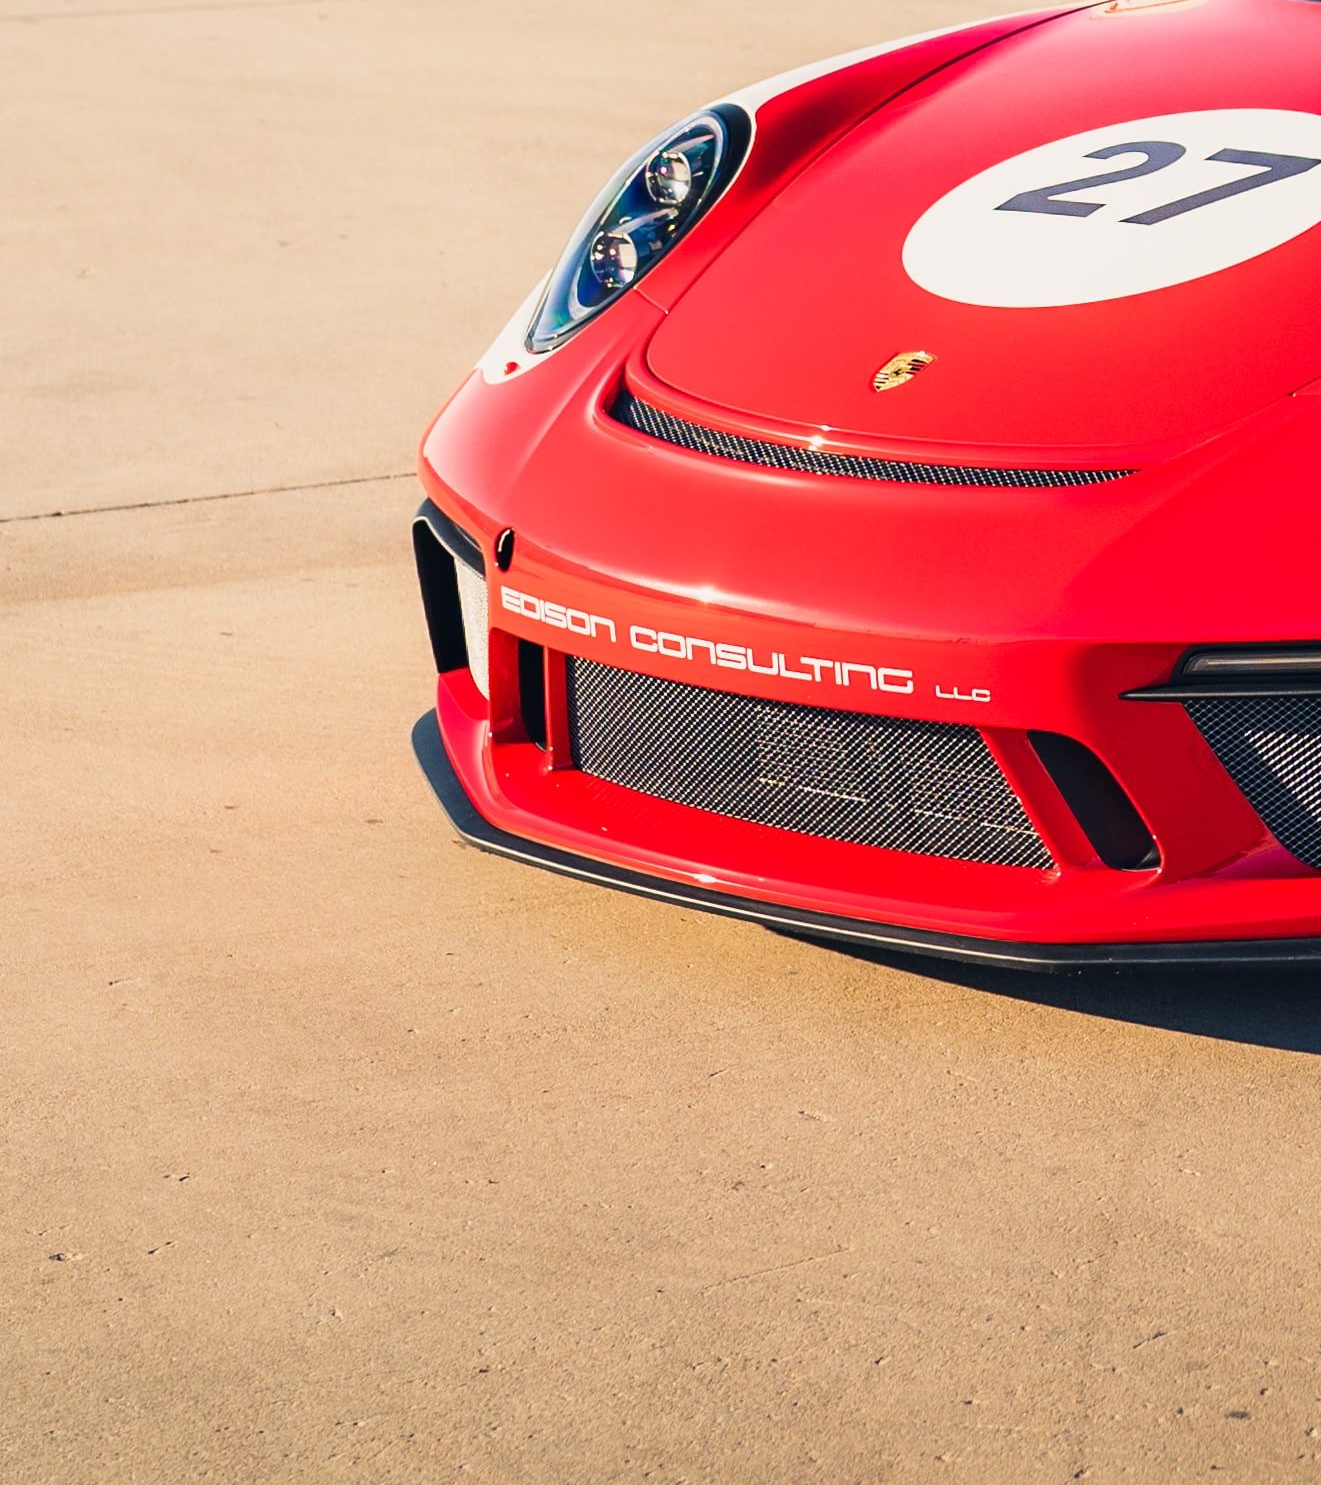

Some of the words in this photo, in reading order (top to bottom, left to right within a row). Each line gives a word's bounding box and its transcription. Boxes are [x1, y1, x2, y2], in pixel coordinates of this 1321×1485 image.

[500, 585, 616, 643] EDISON
[629, 624, 914, 695] CONSULTING
[934, 684, 992, 703] LLC
